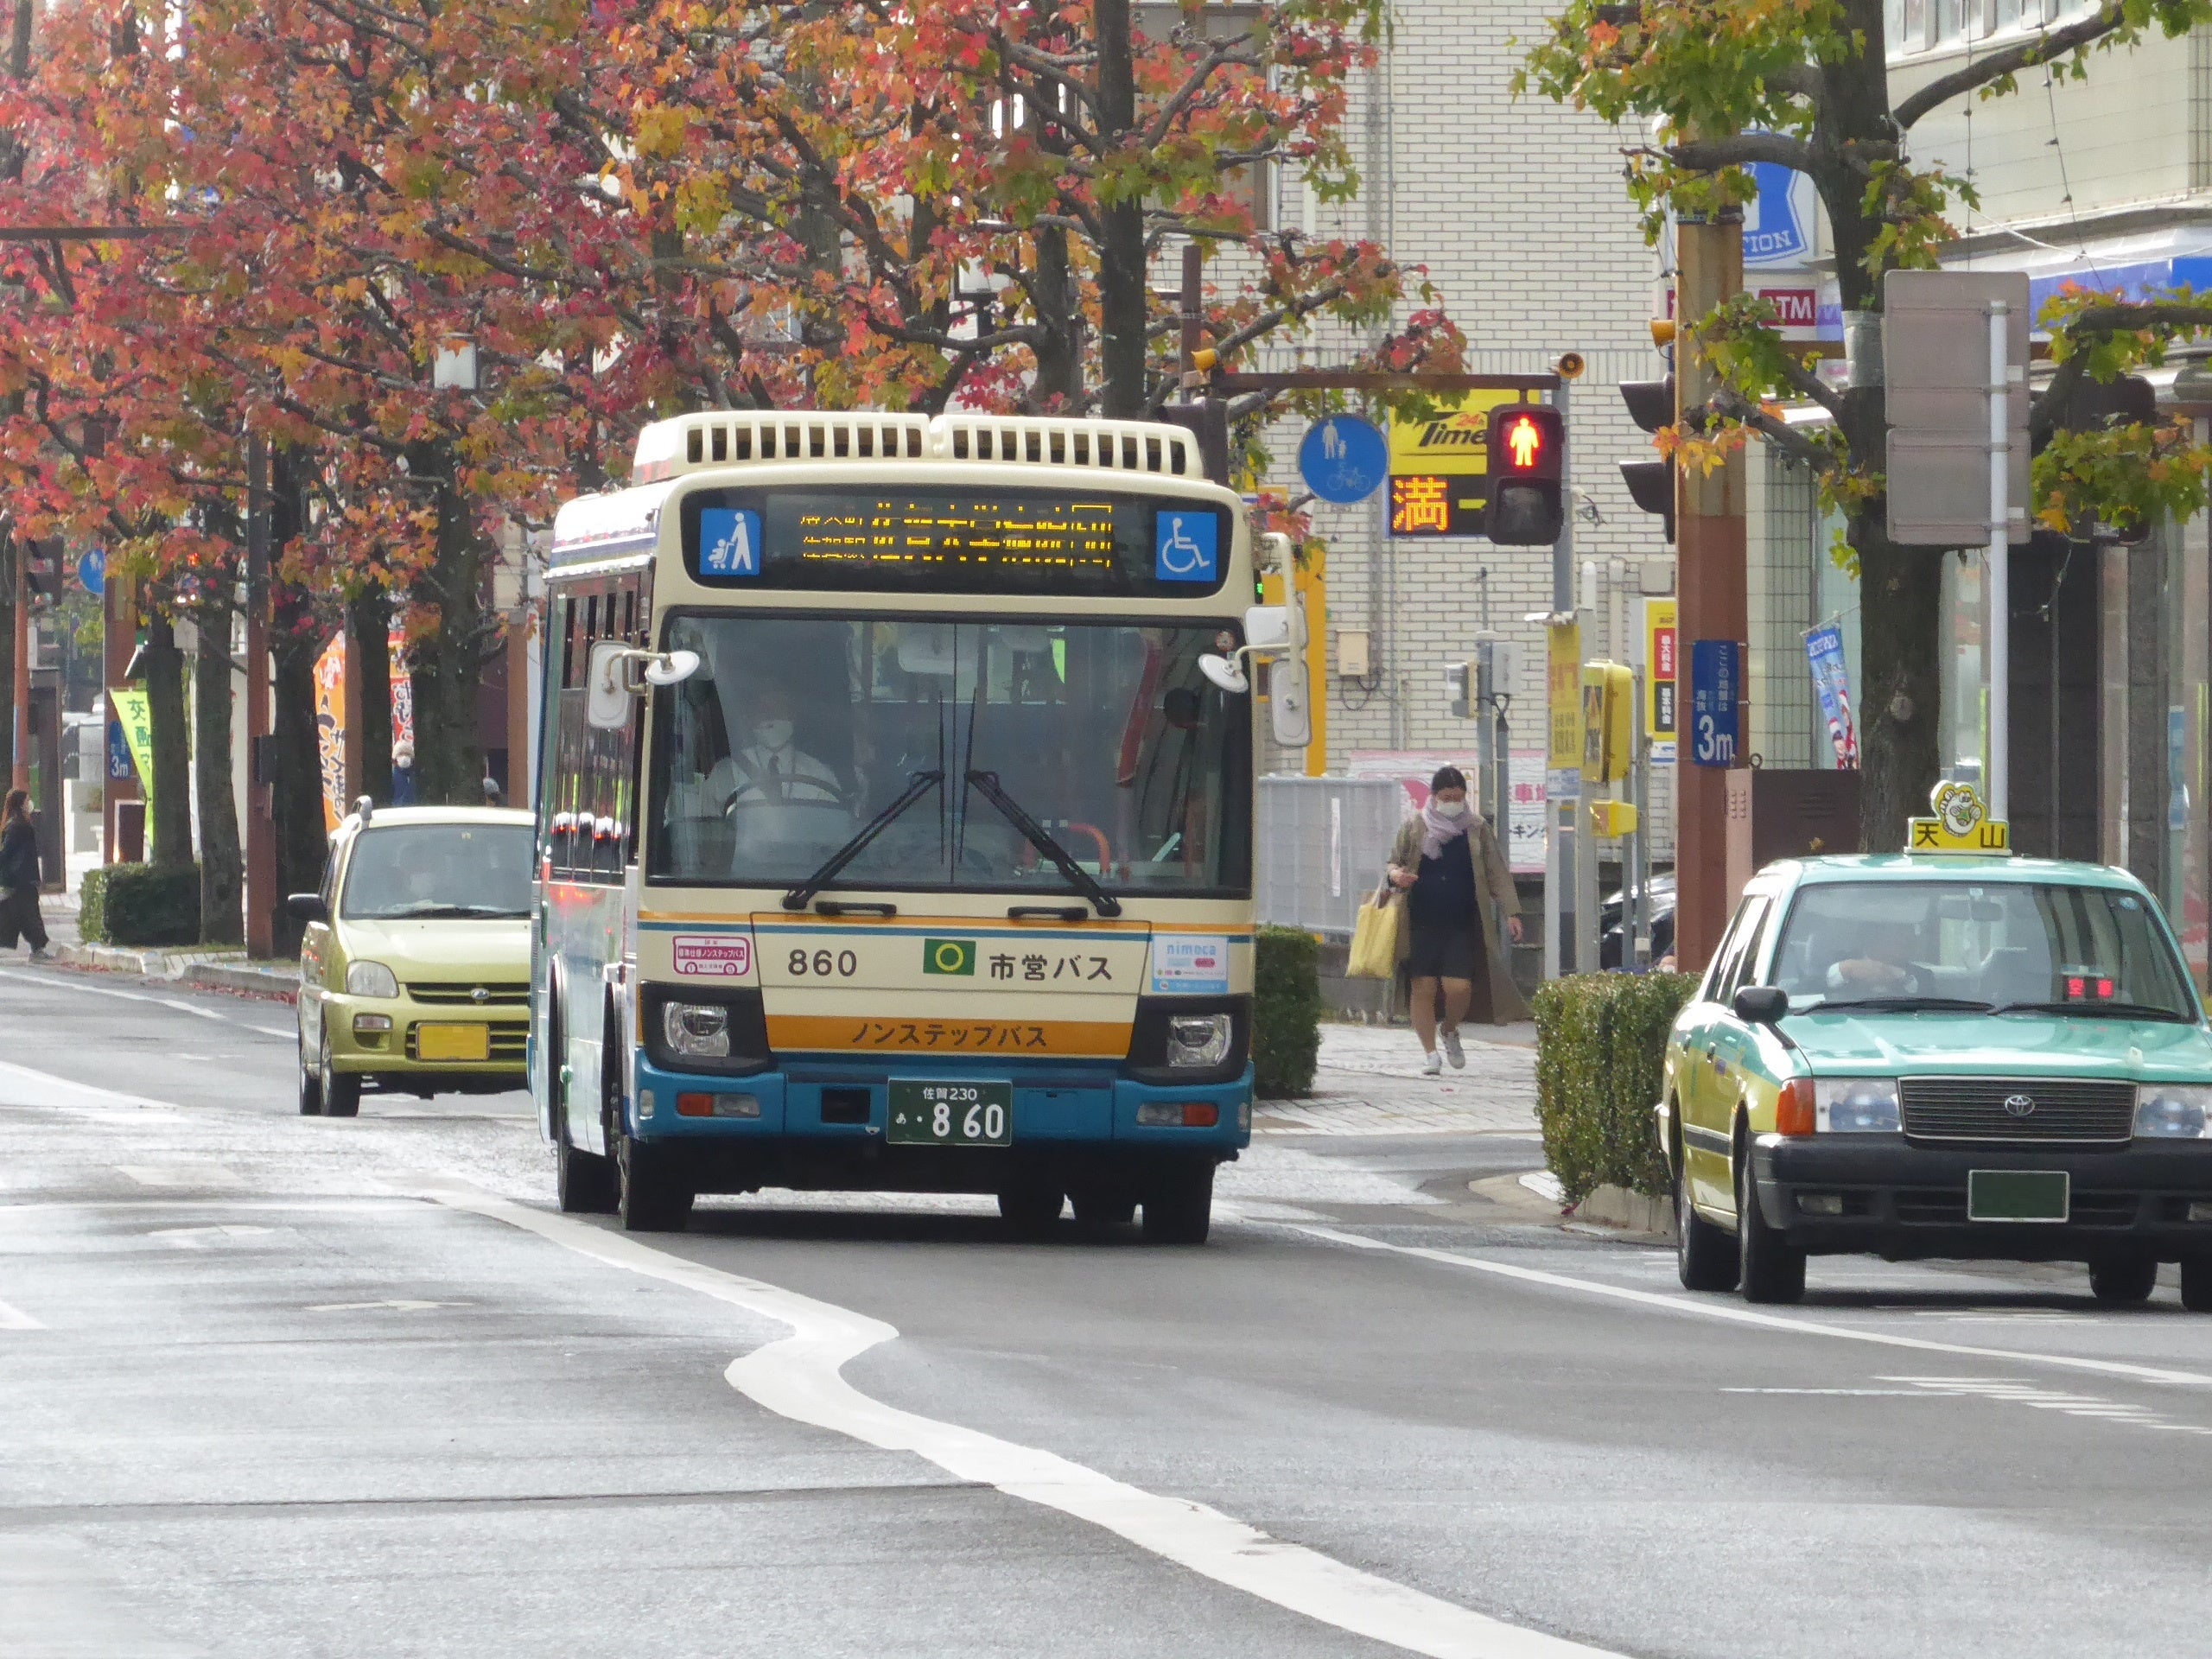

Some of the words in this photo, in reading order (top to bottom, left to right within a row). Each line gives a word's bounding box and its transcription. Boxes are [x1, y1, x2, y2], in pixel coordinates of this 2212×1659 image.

[1418, 422, 1487, 448] Time
[1393, 476, 1448, 532] 満
[1698, 714, 1733, 762] 3m
[111, 755, 129, 779] 3m
[787, 949, 857, 977] 860
[1166, 942, 1217, 957] nimoca
[988, 953, 1113, 982] 市営バス
[852, 1023, 1047, 1048] ノンステップバス
